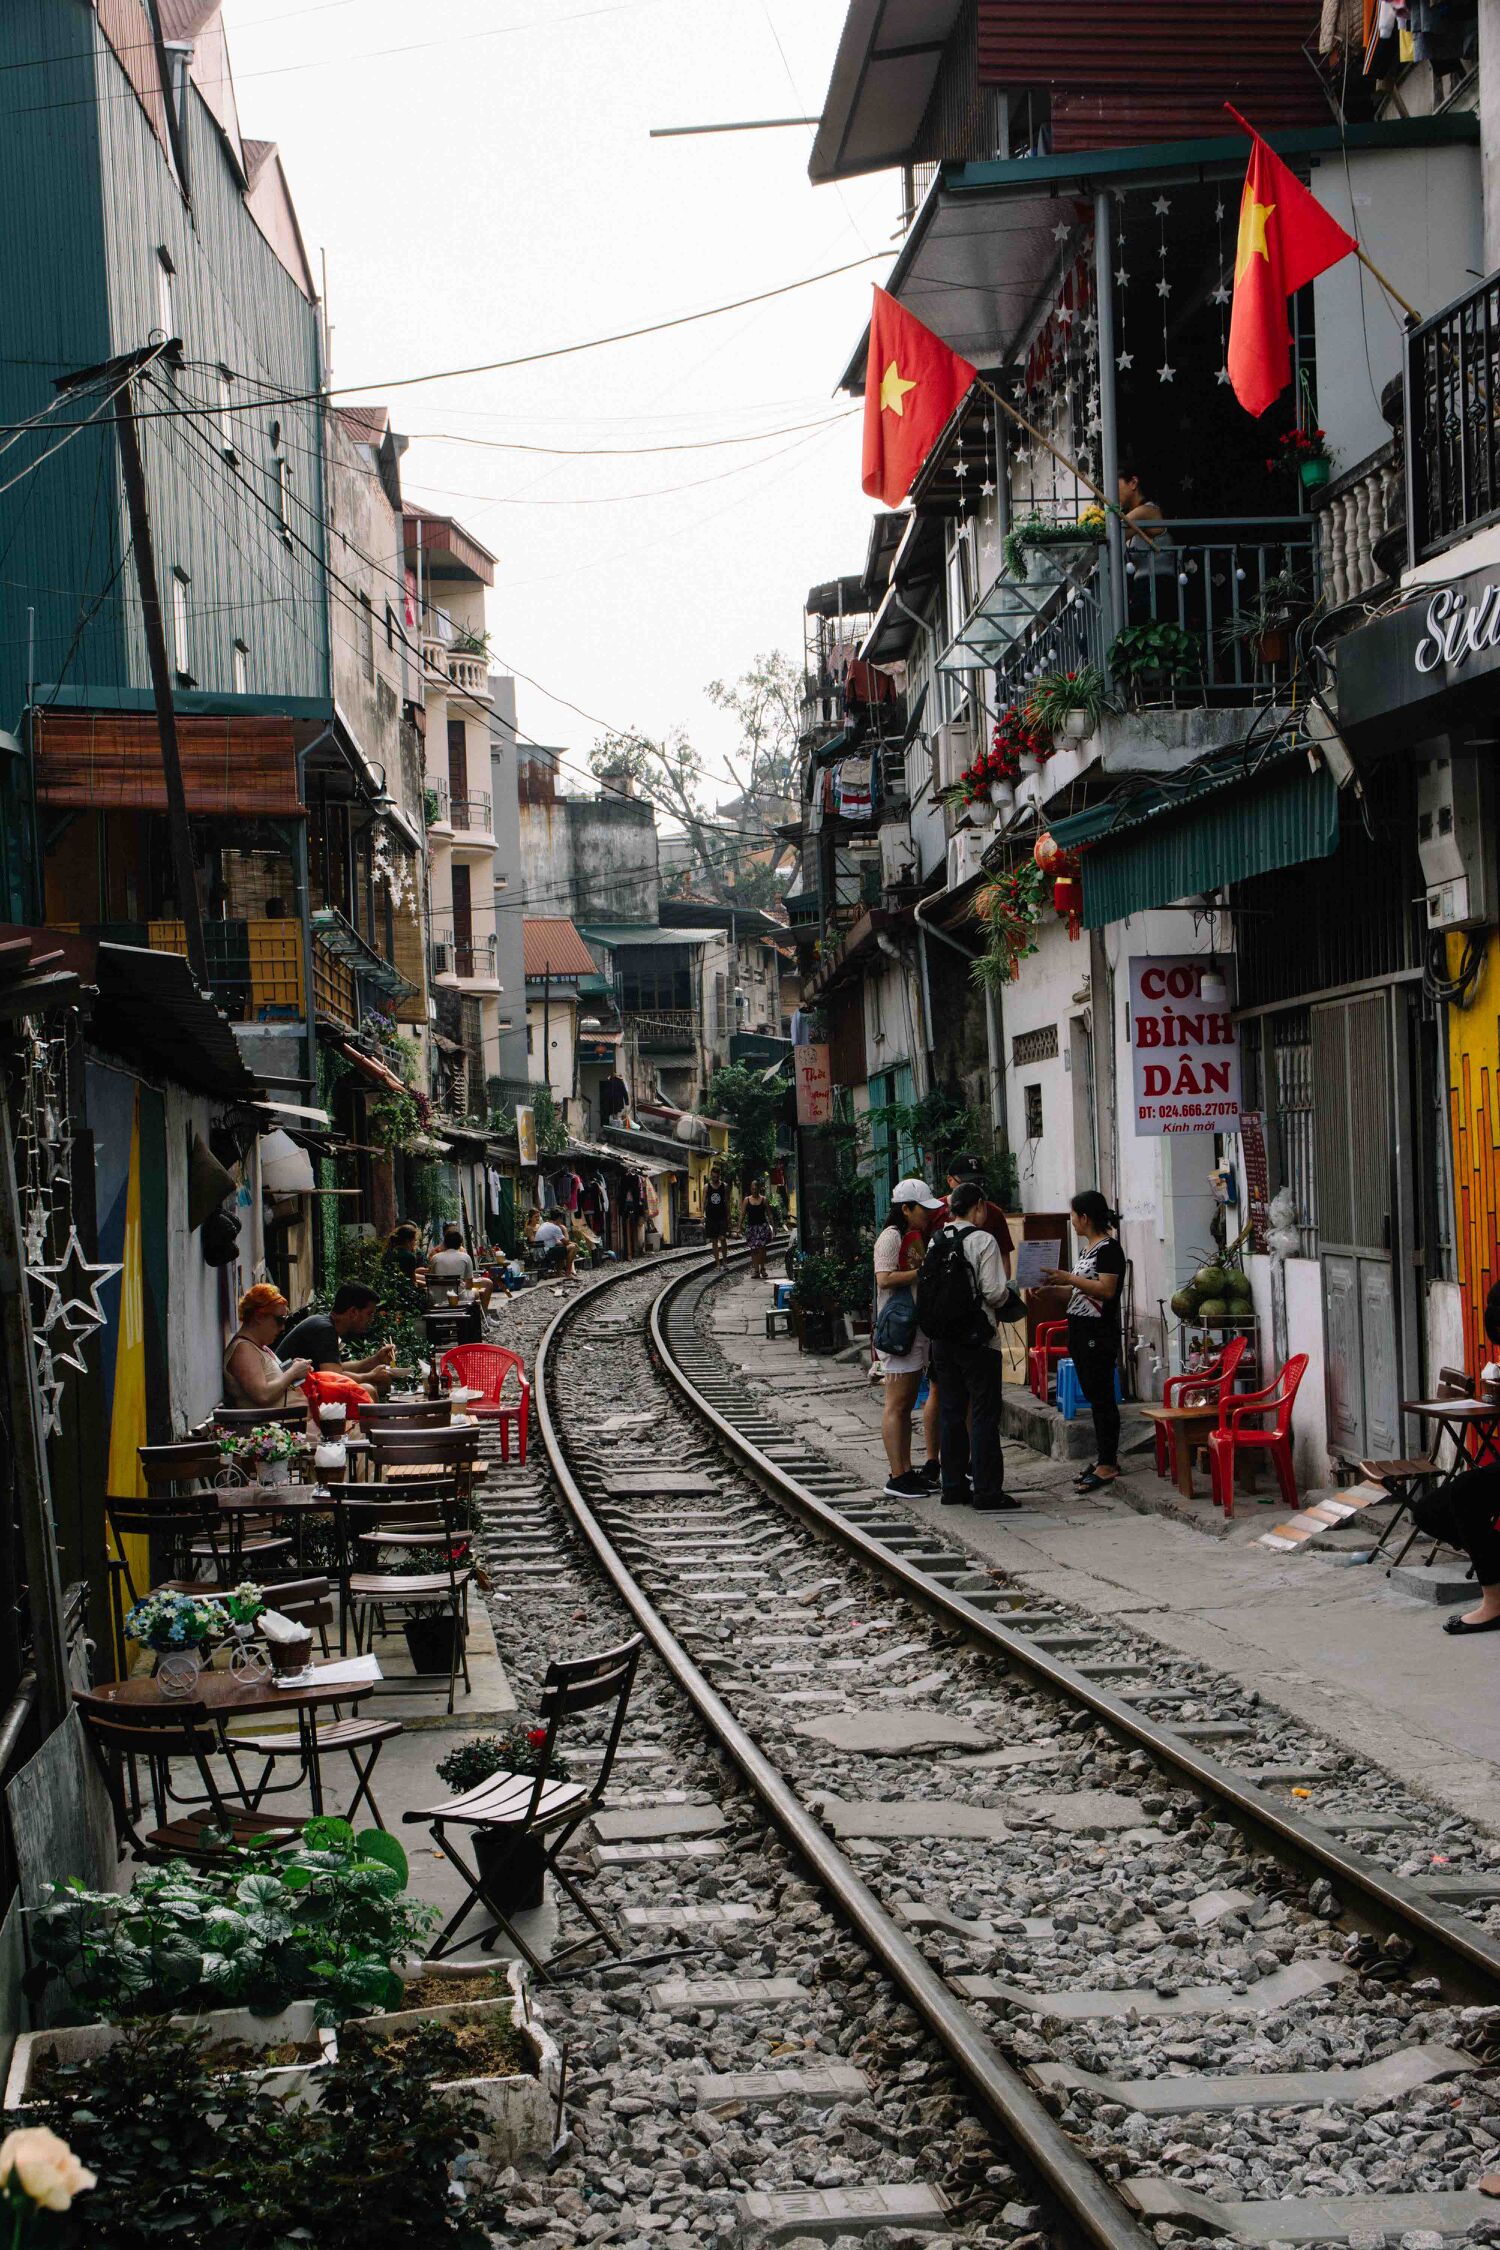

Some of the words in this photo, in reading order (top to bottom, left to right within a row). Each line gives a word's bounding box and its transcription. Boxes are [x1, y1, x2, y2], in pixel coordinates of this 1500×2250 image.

[1135, 1006, 1236, 1048] BÌNH
[1143, 1053, 1231, 1097] DÂN
[1139, 1106, 1156, 1119] ĐT:
[1158, 1102, 1238, 1118] 024.666.27075
[1193, 1121, 1216, 1132] mời
